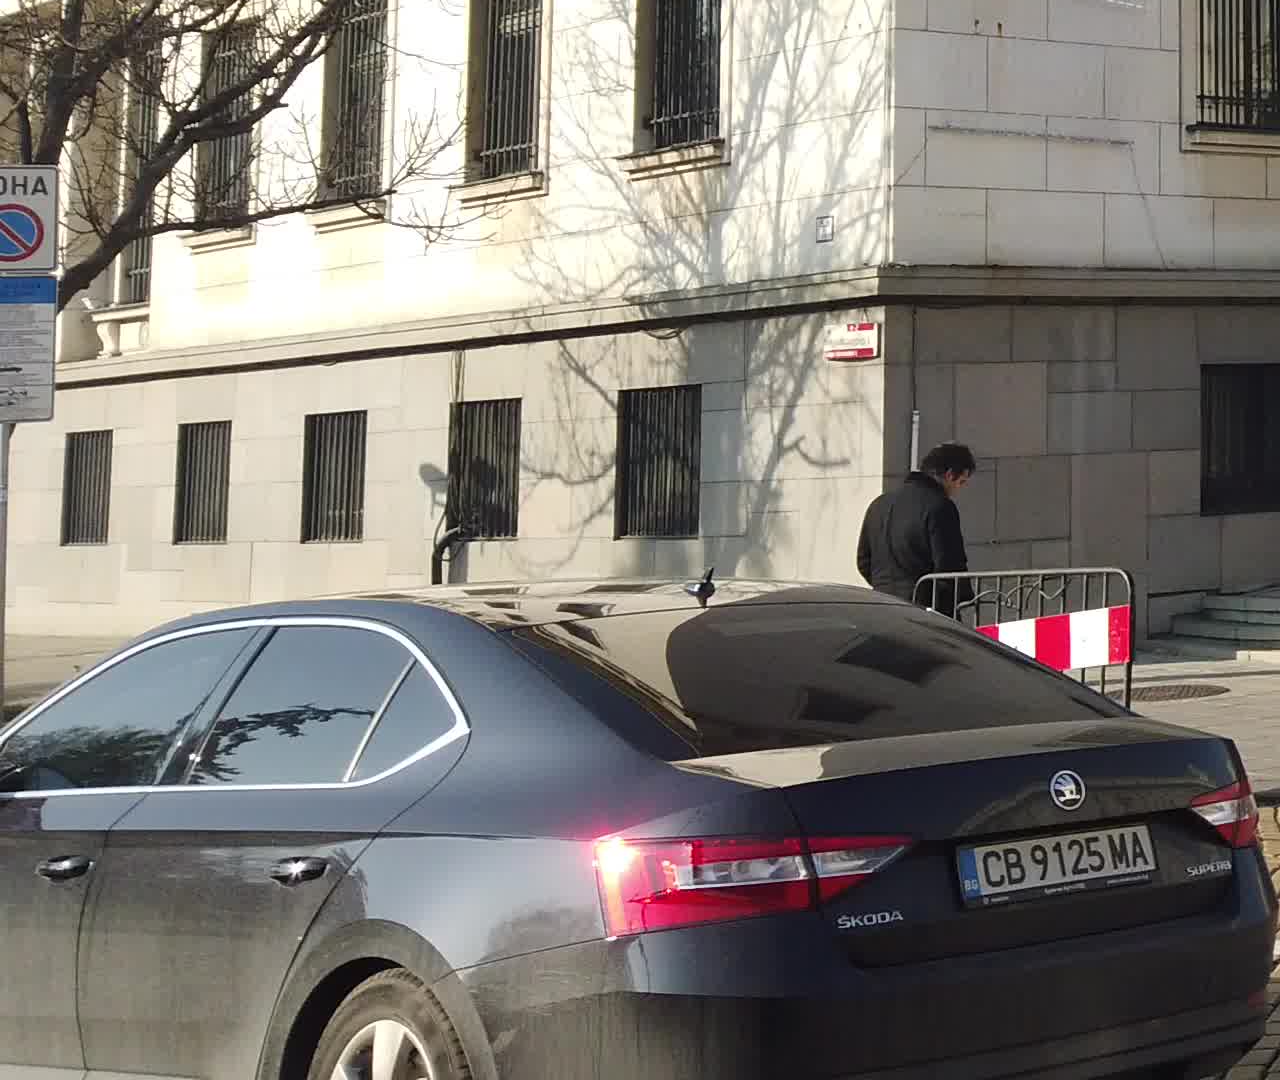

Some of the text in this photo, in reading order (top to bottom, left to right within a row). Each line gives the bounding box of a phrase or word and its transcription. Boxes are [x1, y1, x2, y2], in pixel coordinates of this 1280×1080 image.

[982, 830, 1150, 889] CB 9125 MA
